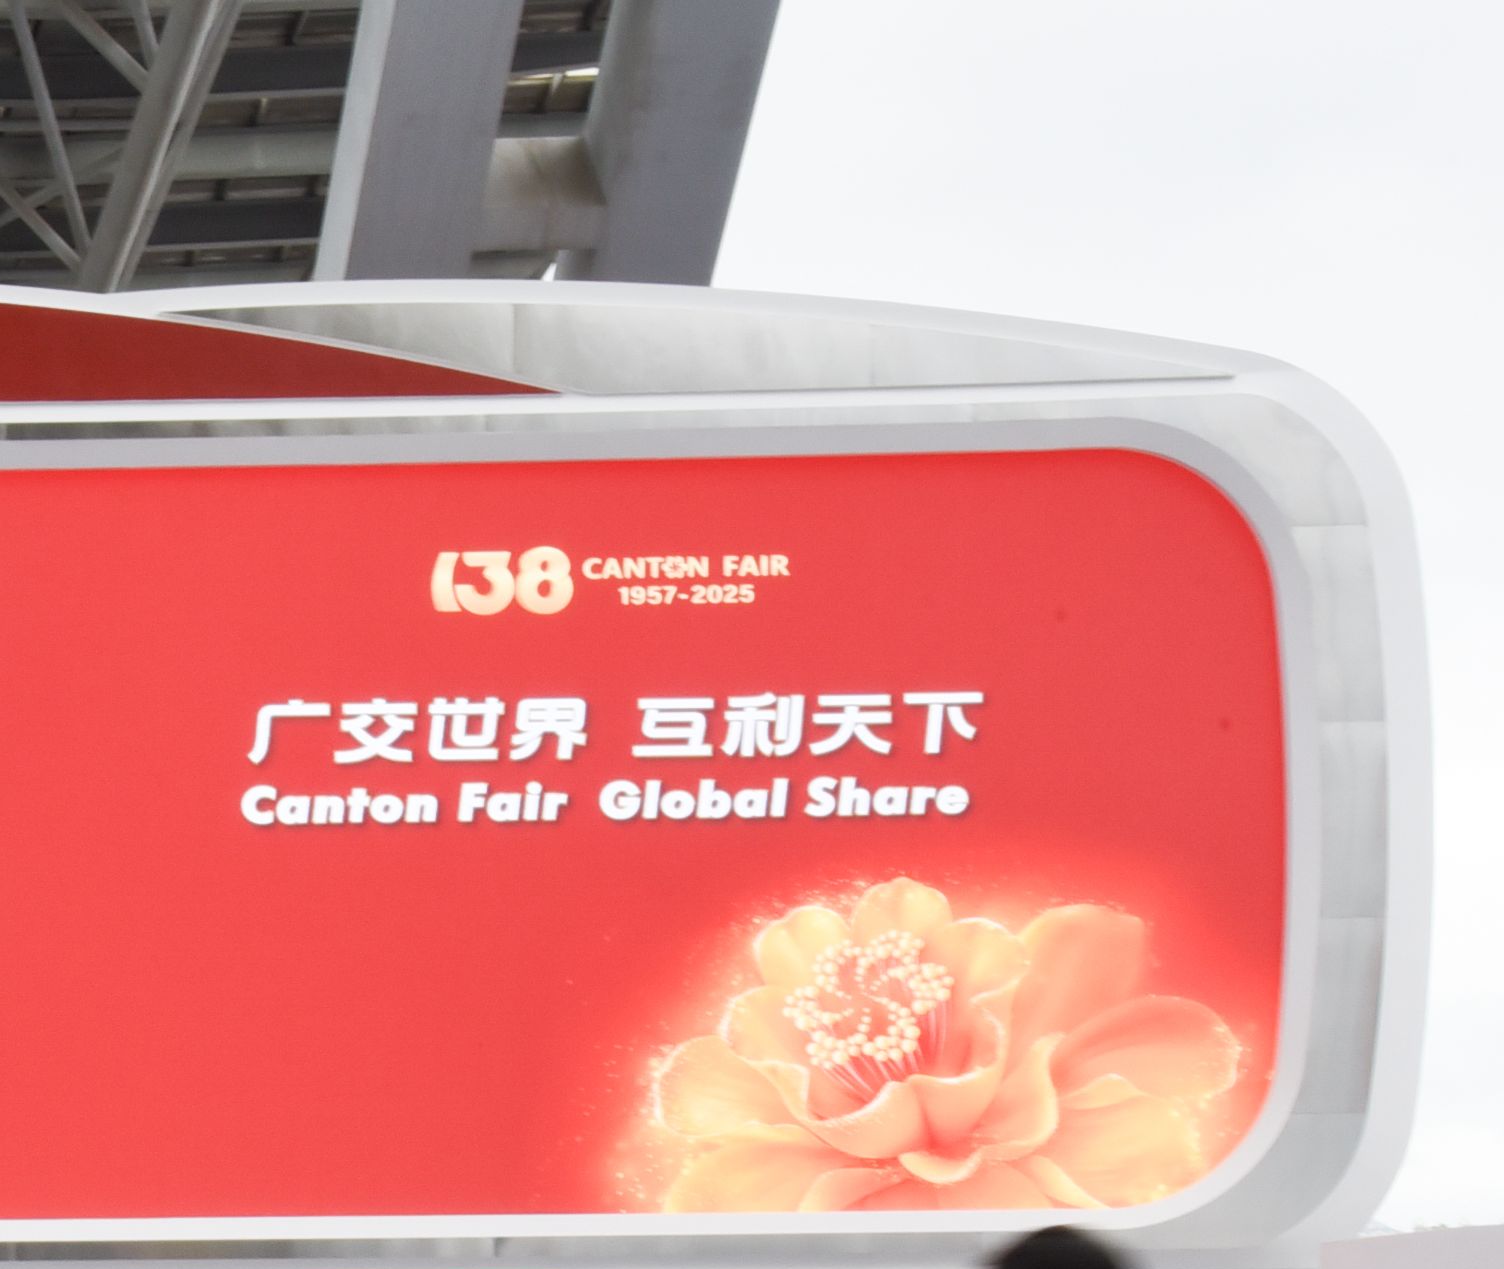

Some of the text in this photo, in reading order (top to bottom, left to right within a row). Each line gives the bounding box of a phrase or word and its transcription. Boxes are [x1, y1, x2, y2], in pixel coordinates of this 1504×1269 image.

[431, 546, 574, 615] 138
[582, 554, 790, 580] CANTON FAIR
[618, 584, 755, 605] 1957-2025
[247, 691, 983, 764] 广交世界 互利天下
[240, 776, 969, 825] Canton Fair Global Share
